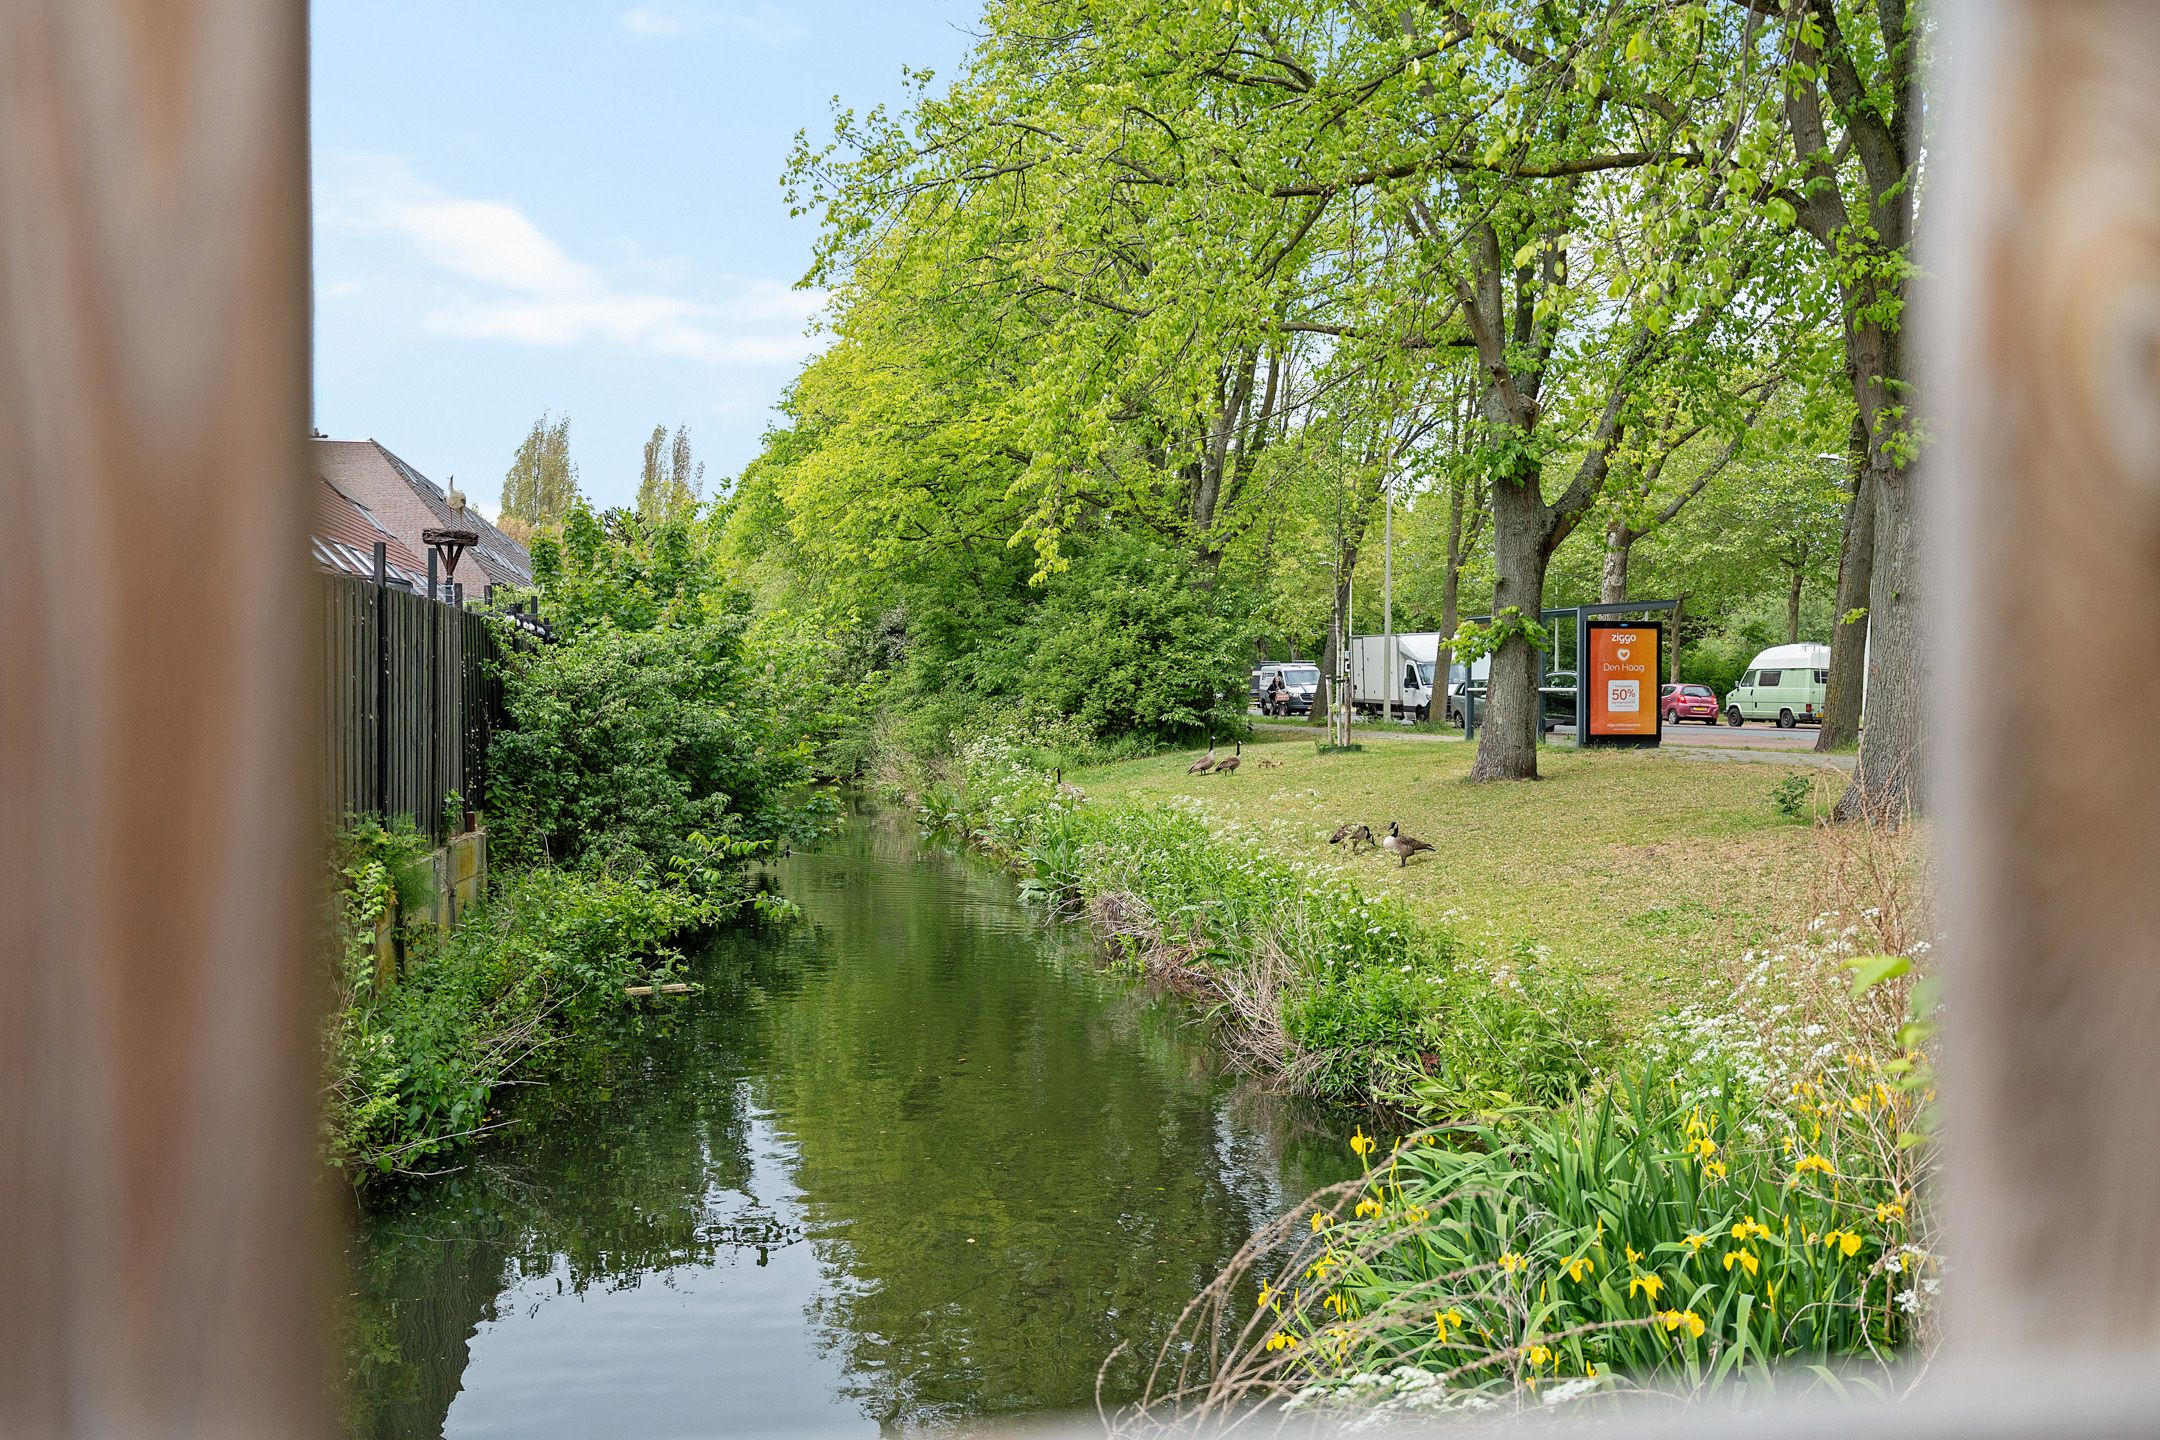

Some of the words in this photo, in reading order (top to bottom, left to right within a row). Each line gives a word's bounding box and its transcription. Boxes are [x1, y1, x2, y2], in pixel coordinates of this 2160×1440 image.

[1611, 633, 1636, 644] ziggo
[1603, 663, 1619, 672] Den
[1622, 663, 1645, 673] Haag
[1612, 688, 1636, 701] 50%
